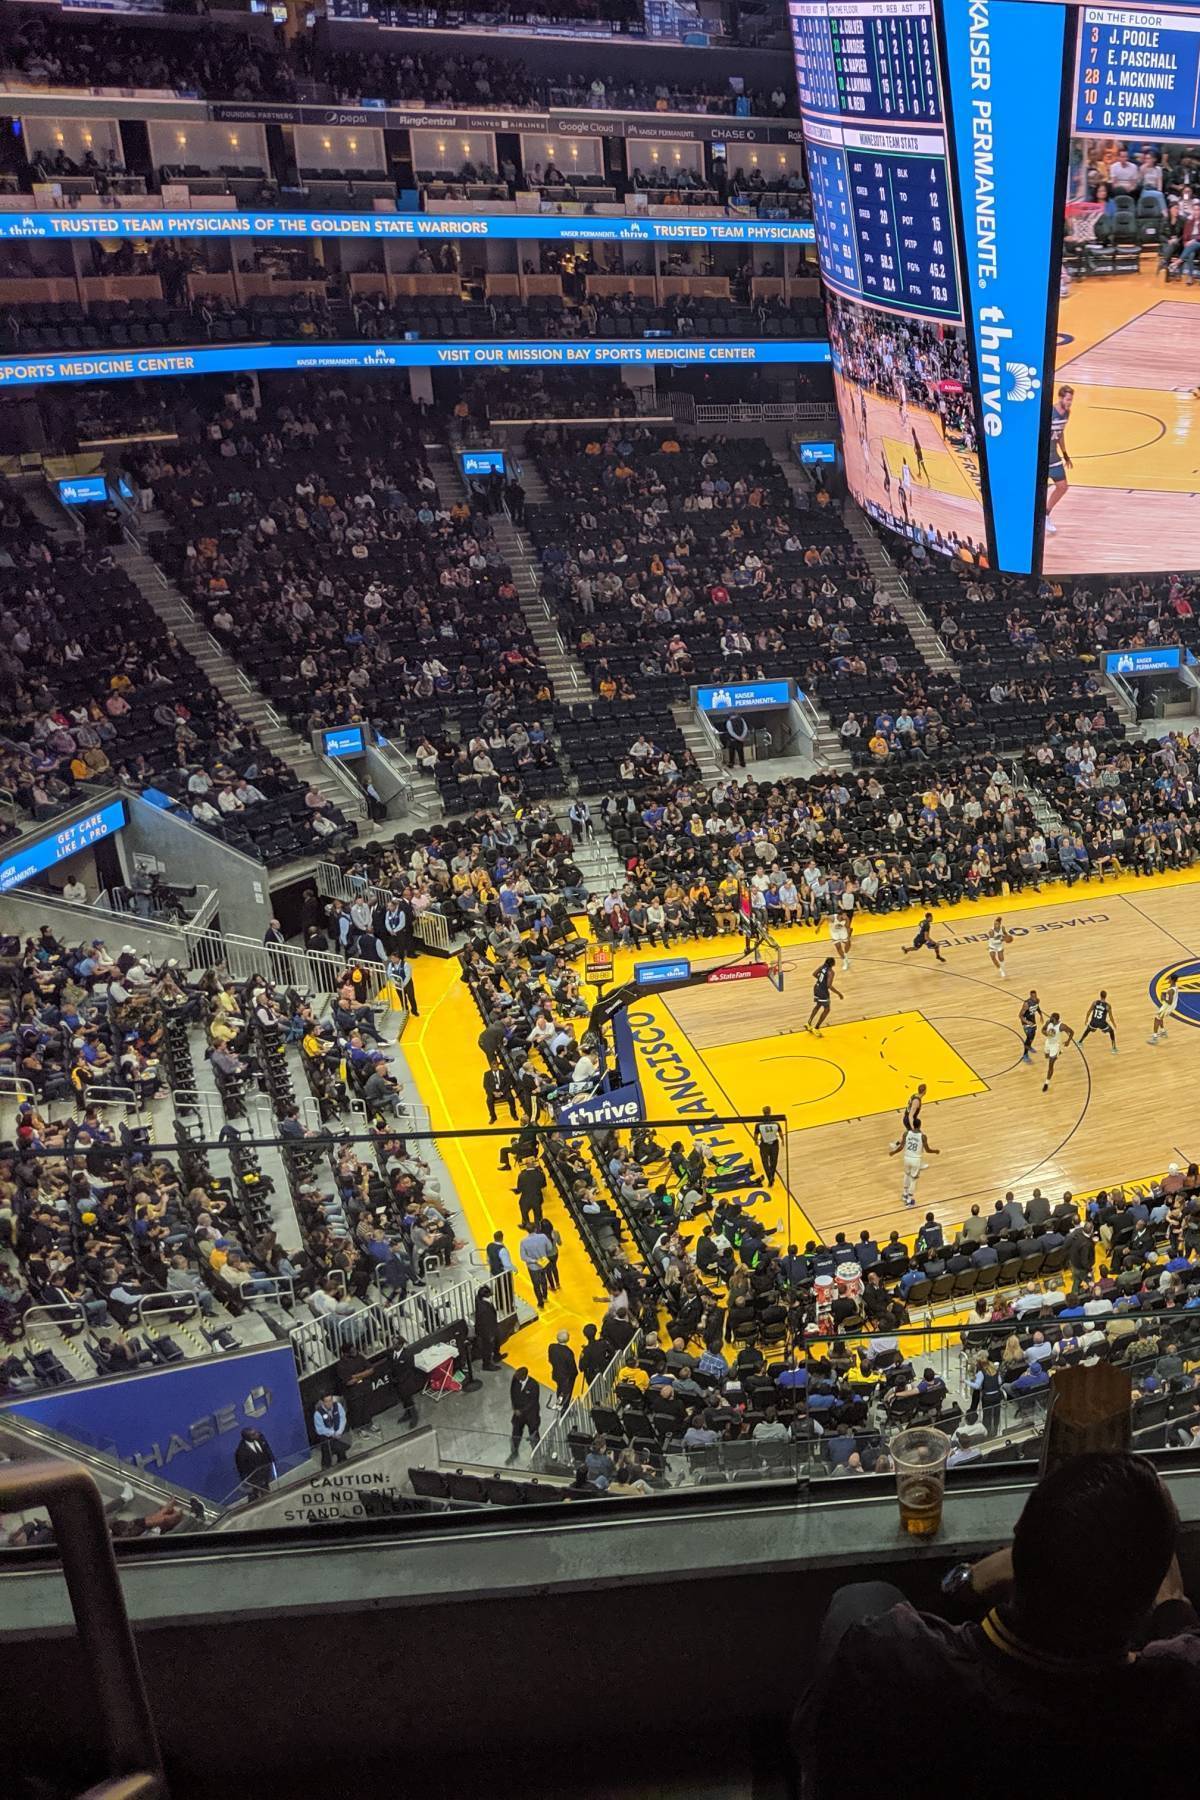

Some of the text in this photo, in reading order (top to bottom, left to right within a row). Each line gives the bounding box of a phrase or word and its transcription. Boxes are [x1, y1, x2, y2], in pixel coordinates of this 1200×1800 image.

[1089, 12, 1104, 21] ON
[1107, 13, 1126, 23] THE
[1129, 14, 1162, 26] FLOOR
[969, 0, 991, 90] KAISER
[1091, 27, 1159, 48] 3 J. POOLE
[1091, 48, 1178, 70] 7 E. PASCHALL
[1085, 69, 1175, 90] 28 A. MCKINNIE
[1084, 90, 1155, 109] 10 J. EVANS
[258, 111, 294, 120] PARTNERS
[340, 112, 367, 125] pepsi
[400, 115, 456, 126] RingCentral
[1085, 110, 1175, 130] 4 O. SPELLMAN
[471, 120, 545, 130] UNITED AIRLINES
[559, 121, 614, 133] Google Cloud
[639, 128, 657, 137] KAISER
[711, 129, 745, 138] CHASE
[9, 224, 45, 235] thrive
[52, 219, 119, 232] TRUSTED
[123, 219, 164, 231] TEAM
[169, 219, 250, 231] PHYSICIANS
[254, 219, 274, 231] OF
[278, 219, 307, 231] THE
[312, 220, 370, 232] GOLDEN
[375, 220, 414, 232] STATE
[418, 221, 488, 233] WARRIORS
[620, 229, 648, 238] thrive
[654, 225, 707, 236] TRUSTED
[711, 226, 744, 237] TEAM
[748, 228, 815, 239] PHYSICIANS
[364, 355, 395, 365] thrive
[438, 347, 756, 361] VISIT OUR MISSION BAY SPORTS MEDICINE CENTER
[0, 357, 194, 380] SPORTS MEDICINE CENTER
[980, 306, 1013, 437] thrive
[57, 814, 102, 844] GET CARE
[56, 825, 107, 858] LIKE A PRO
[1032, 914, 1110, 933] CHASE
[1094, 1008, 1103, 1019] 13
[568, 1100, 638, 1126] thrive
[907, 1142, 918, 1151] 28
[310, 1472, 390, 1488] CAUTION:
[302, 1492, 325, 1504] DO
[331, 1489, 366, 1502] NOT
